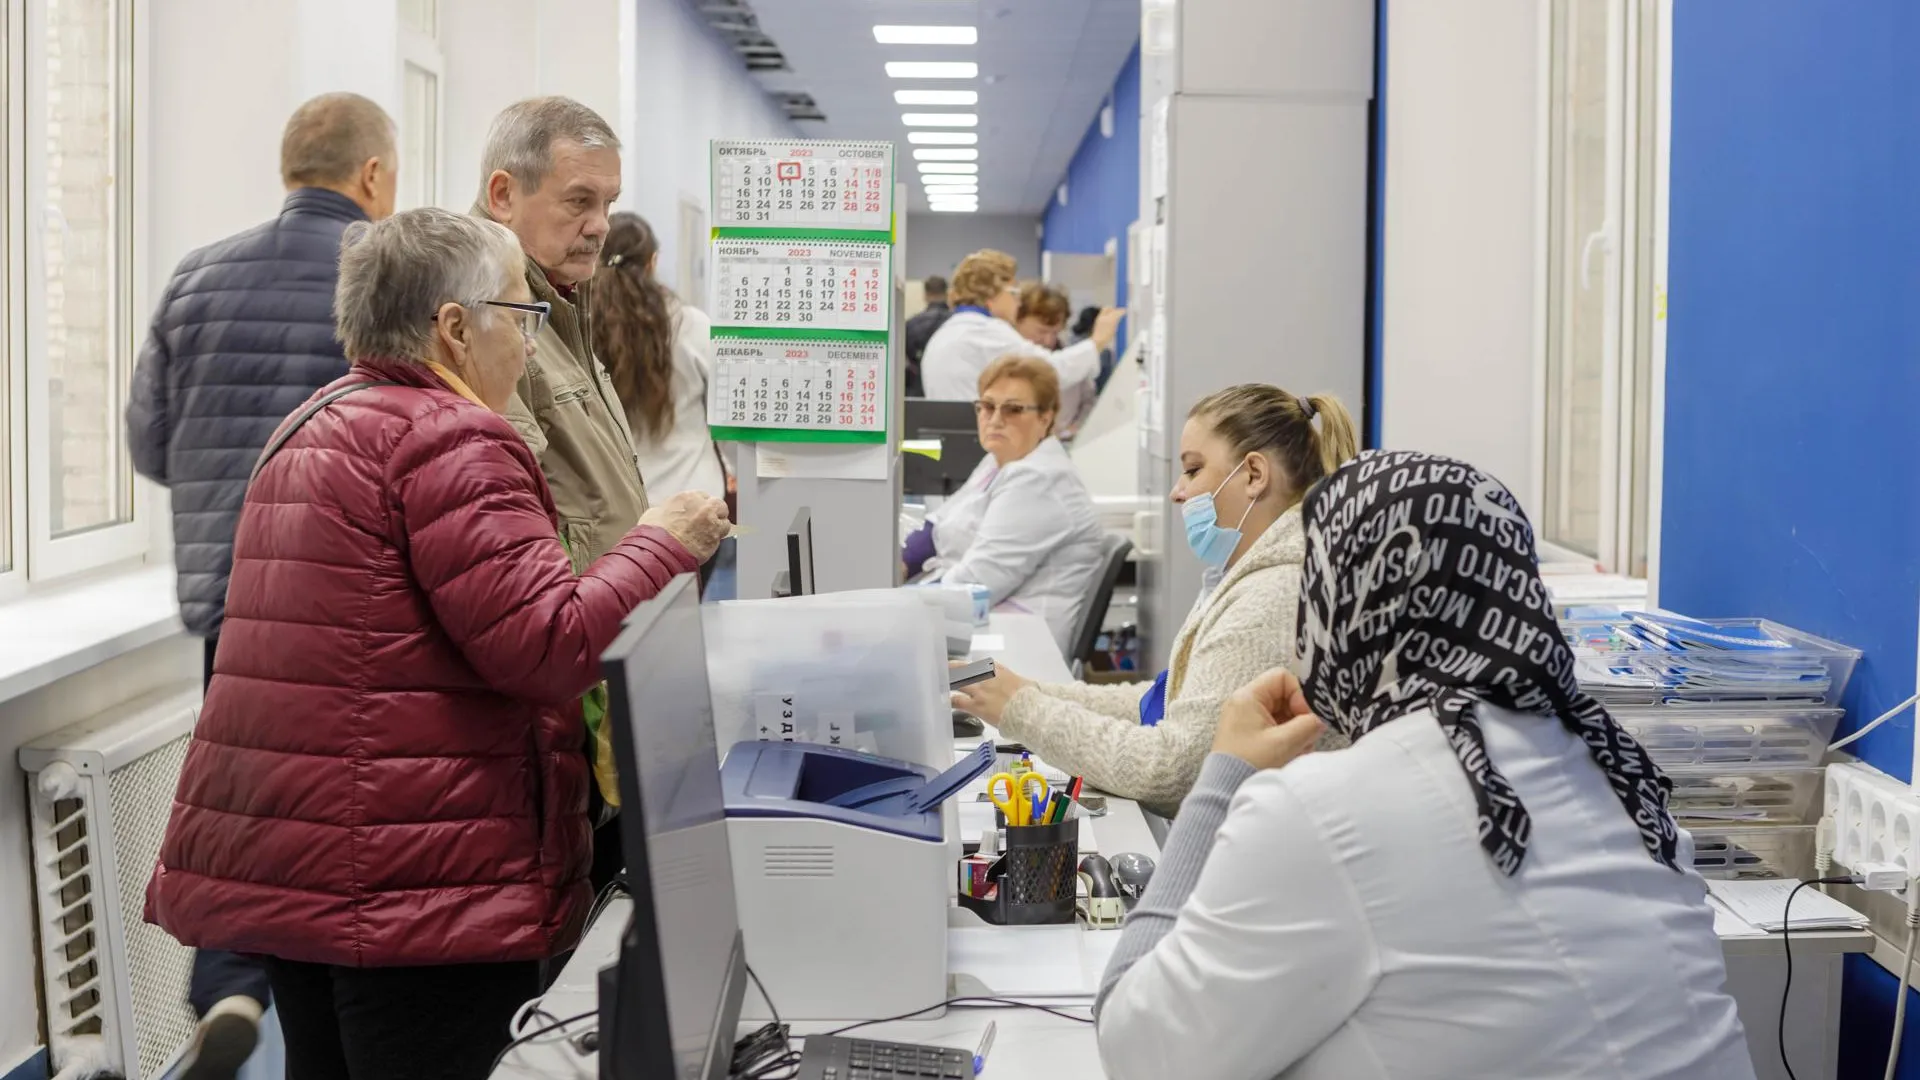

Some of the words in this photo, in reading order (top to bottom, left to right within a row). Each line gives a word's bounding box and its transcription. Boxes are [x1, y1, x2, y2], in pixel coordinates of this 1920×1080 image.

[719, 148, 766, 156] ОКТЯБРЬ
[790, 149, 814, 157] 2023
[839, 150, 884, 158] OCTOBER
[744, 166, 751, 174] 2
[765, 166, 771, 174] 3
[786, 166, 793, 175] 4
[808, 167, 815, 176] 5
[830, 167, 837, 176] 6
[852, 168, 858, 177] 7
[744, 177, 750, 186] 9
[758, 178, 771, 186] 10
[801, 178, 815, 187] 12
[823, 179, 837, 188] 13
[844, 179, 858, 188] 14
[866, 180, 880, 189] 15
[737, 189, 750, 197] 16
[758, 189, 771, 198] 17
[779, 190, 792, 198] 18
[801, 190, 814, 199] 19
[822, 190, 836, 199] 20
[844, 191, 857, 199] 21
[865, 192, 880, 200] 22
[736, 200, 750, 208] 23
[756, 200, 770, 209] 24
[778, 200, 792, 209] 25
[800, 201, 814, 210] 26
[822, 201, 836, 210] 27
[843, 202, 858, 211] 28
[865, 203, 880, 212] 29
[736, 212, 750, 220] 30
[756, 212, 770, 220] 31
[719, 248, 759, 256] НОЯБРЬ
[788, 249, 812, 257] 2023
[829, 250, 882, 259] NOVEMBER
[785, 267, 790, 275] 1
[806, 267, 813, 275] 2
[828, 267, 835, 276] 3
[849, 268, 856, 277] 4
[872, 269, 878, 278] 5
[742, 277, 748, 286] 6
[763, 277, 770, 286] 7
[784, 277, 791, 286] 8
[806, 278, 813, 287] 9
[820, 278, 835, 288] 10
[842, 280, 856, 288] 11
[864, 280, 878, 289] 12
[735, 288, 748, 297] 13
[756, 289, 769, 298] 14
[777, 289, 791, 298] 15
[798, 290, 812, 299] 16
[820, 290, 834, 299] 17
[842, 291, 856, 300] 18
[864, 292, 878, 301] 19
[734, 300, 748, 308] 20
[755, 300, 768, 309] 21
[776, 301, 790, 310] 22
[798, 301, 812, 310] 23
[820, 302, 834, 311] 24
[842, 302, 856, 311] 25
[863, 303, 878, 312] 26
[734, 312, 748, 320] 27
[755, 312, 769, 321] 28
[776, 312, 790, 321] 29
[798, 312, 813, 322] 30
[716, 348, 763, 357] ДЕКАБРЬ
[785, 350, 809, 358] 2023
[827, 351, 878, 360] DECEMBER
[826, 369, 832, 378] 1
[847, 369, 854, 378] 2
[869, 370, 875, 379] 3
[739, 378, 746, 386] 4
[761, 378, 768, 387] 5
[782, 379, 789, 387] 6
[804, 380, 811, 388] 7
[825, 380, 832, 389] 8
[847, 381, 854, 390] 9
[861, 382, 875, 391] 10
[732, 389, 746, 398] 11
[754, 390, 768, 399] 12
[774, 390, 789, 399] 13
[796, 391, 810, 400] 14
[818, 391, 832, 400] 15
[840, 392, 854, 401] 16
[861, 393, 875, 402] 17
[732, 401, 746, 409] 18
[754, 401, 767, 410] 19
[774, 402, 789, 411] 20
[796, 402, 809, 411] 21
[817, 403, 832, 412] 22
[839, 404, 853, 413] 23
[860, 404, 874, 414] 24
[732, 412, 745, 420] 25
[752, 412, 767, 422] 26
[774, 413, 788, 422] 27
[796, 414, 810, 423] 28
[817, 415, 832, 424] 29
[839, 416, 853, 424] 30
[860, 416, 874, 425] 31
